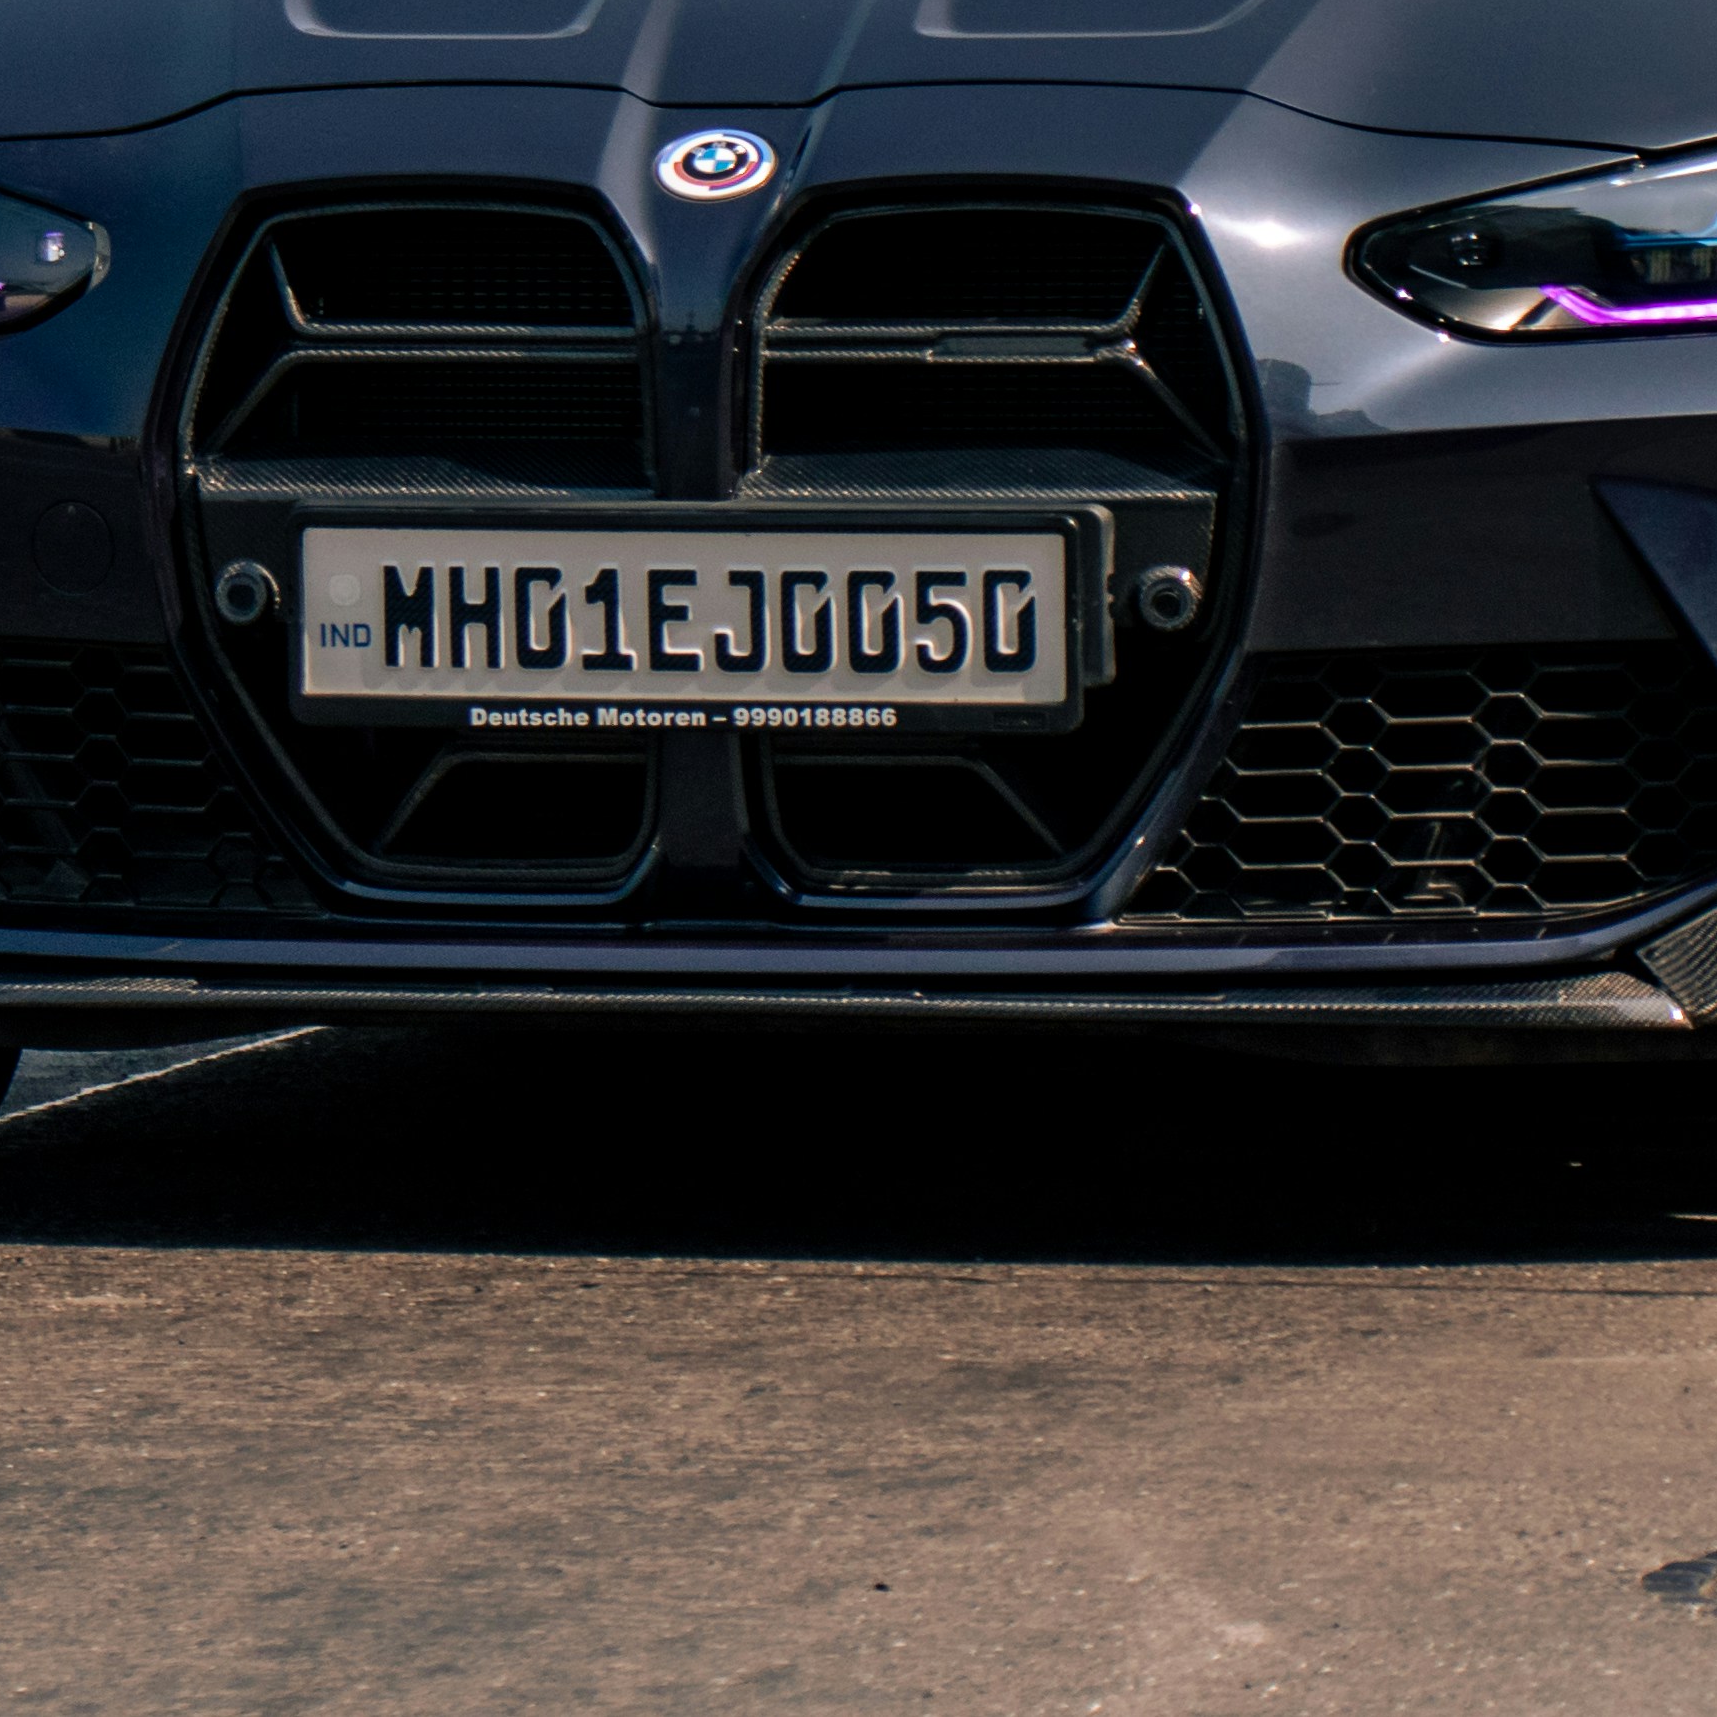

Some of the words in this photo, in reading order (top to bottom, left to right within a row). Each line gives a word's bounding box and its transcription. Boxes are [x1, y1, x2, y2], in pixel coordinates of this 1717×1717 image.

[383, 564, 1038, 674] MH01EJ0050
[319, 622, 373, 649] IND
[470, 707, 590, 728] Deutsche
[596, 707, 708, 728] Motoren
[731, 707, 899, 728] 9990188866
